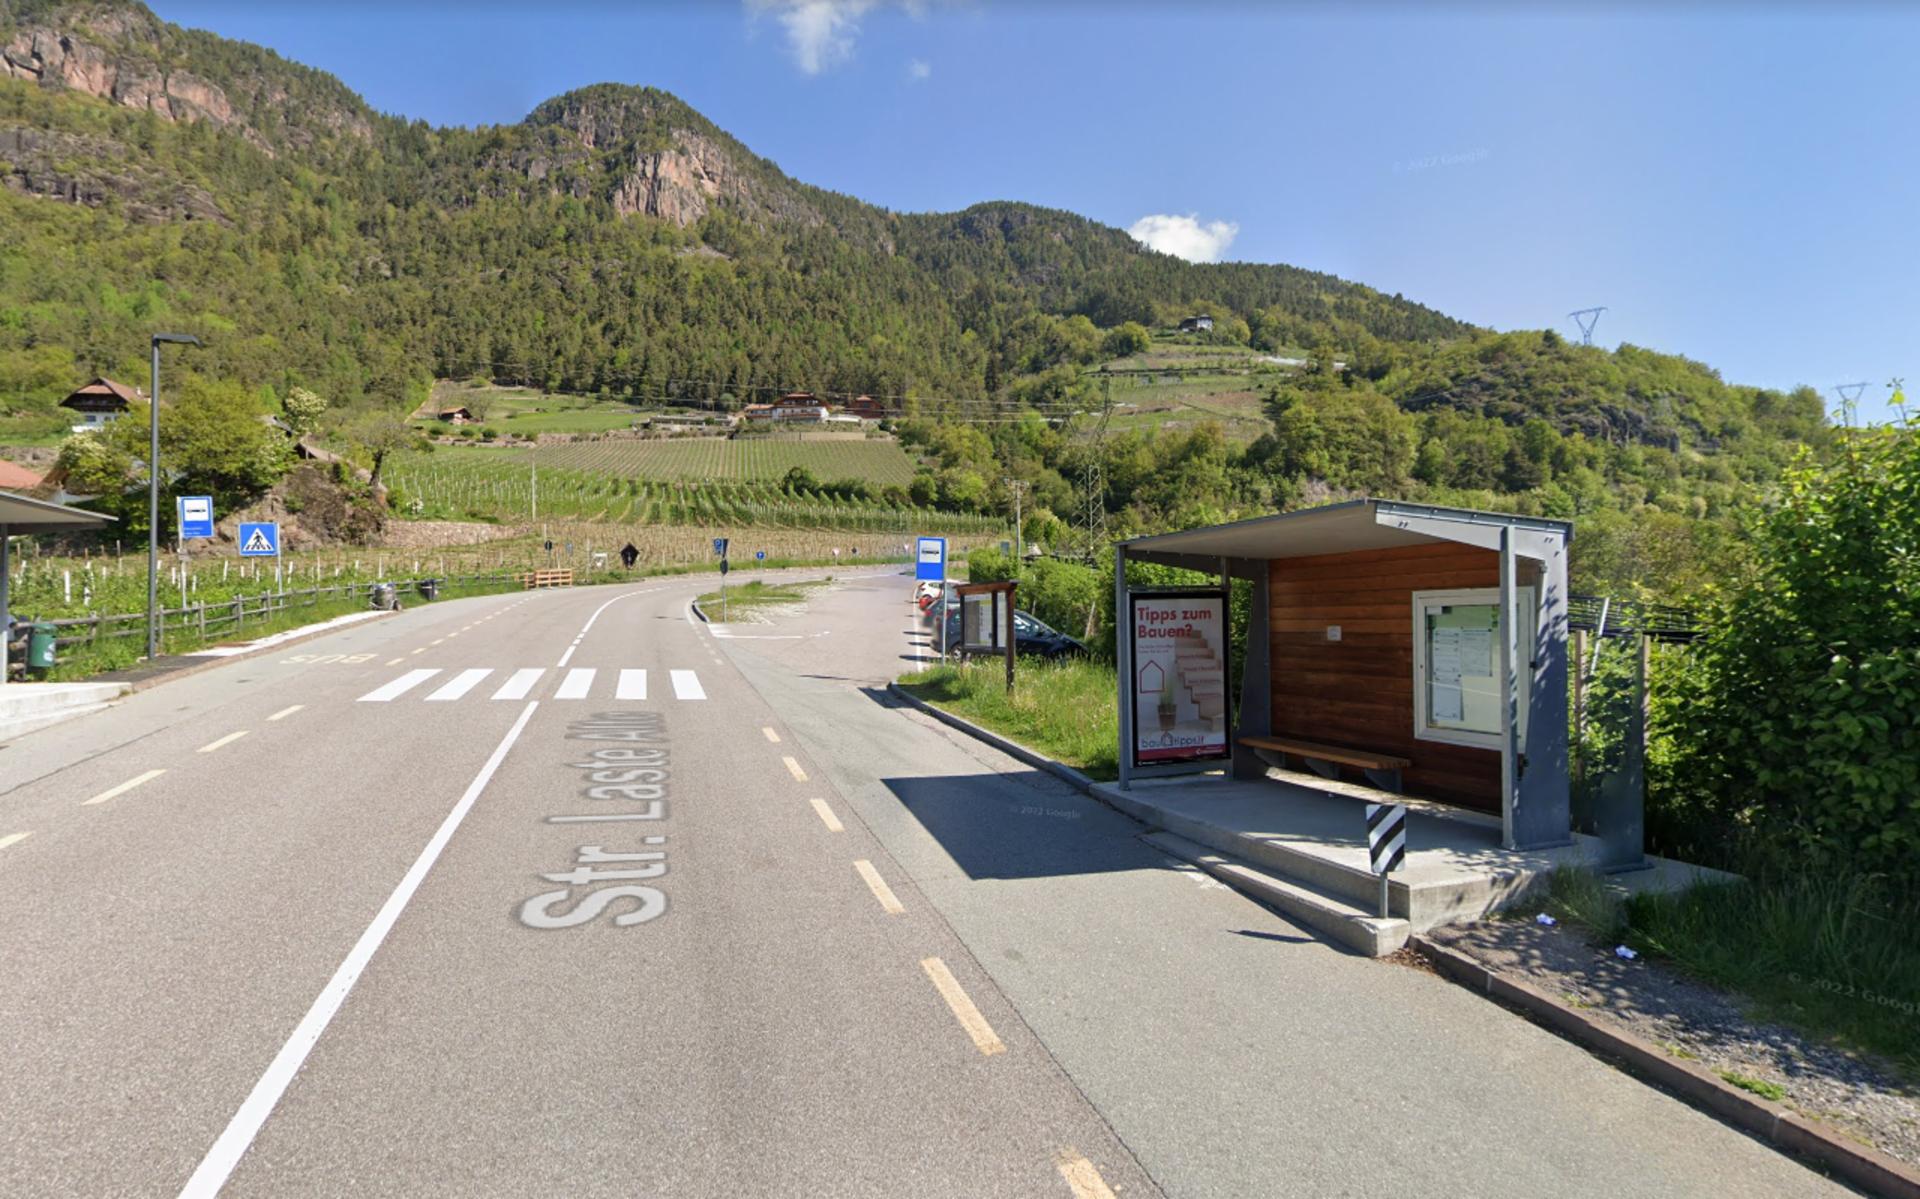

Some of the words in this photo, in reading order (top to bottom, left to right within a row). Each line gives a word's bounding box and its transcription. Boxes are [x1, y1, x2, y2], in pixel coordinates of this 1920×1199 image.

[1137, 606, 1177, 624] Tipps
[1182, 608, 1212, 620] zum
[1138, 624, 1193, 638] Bauen?
